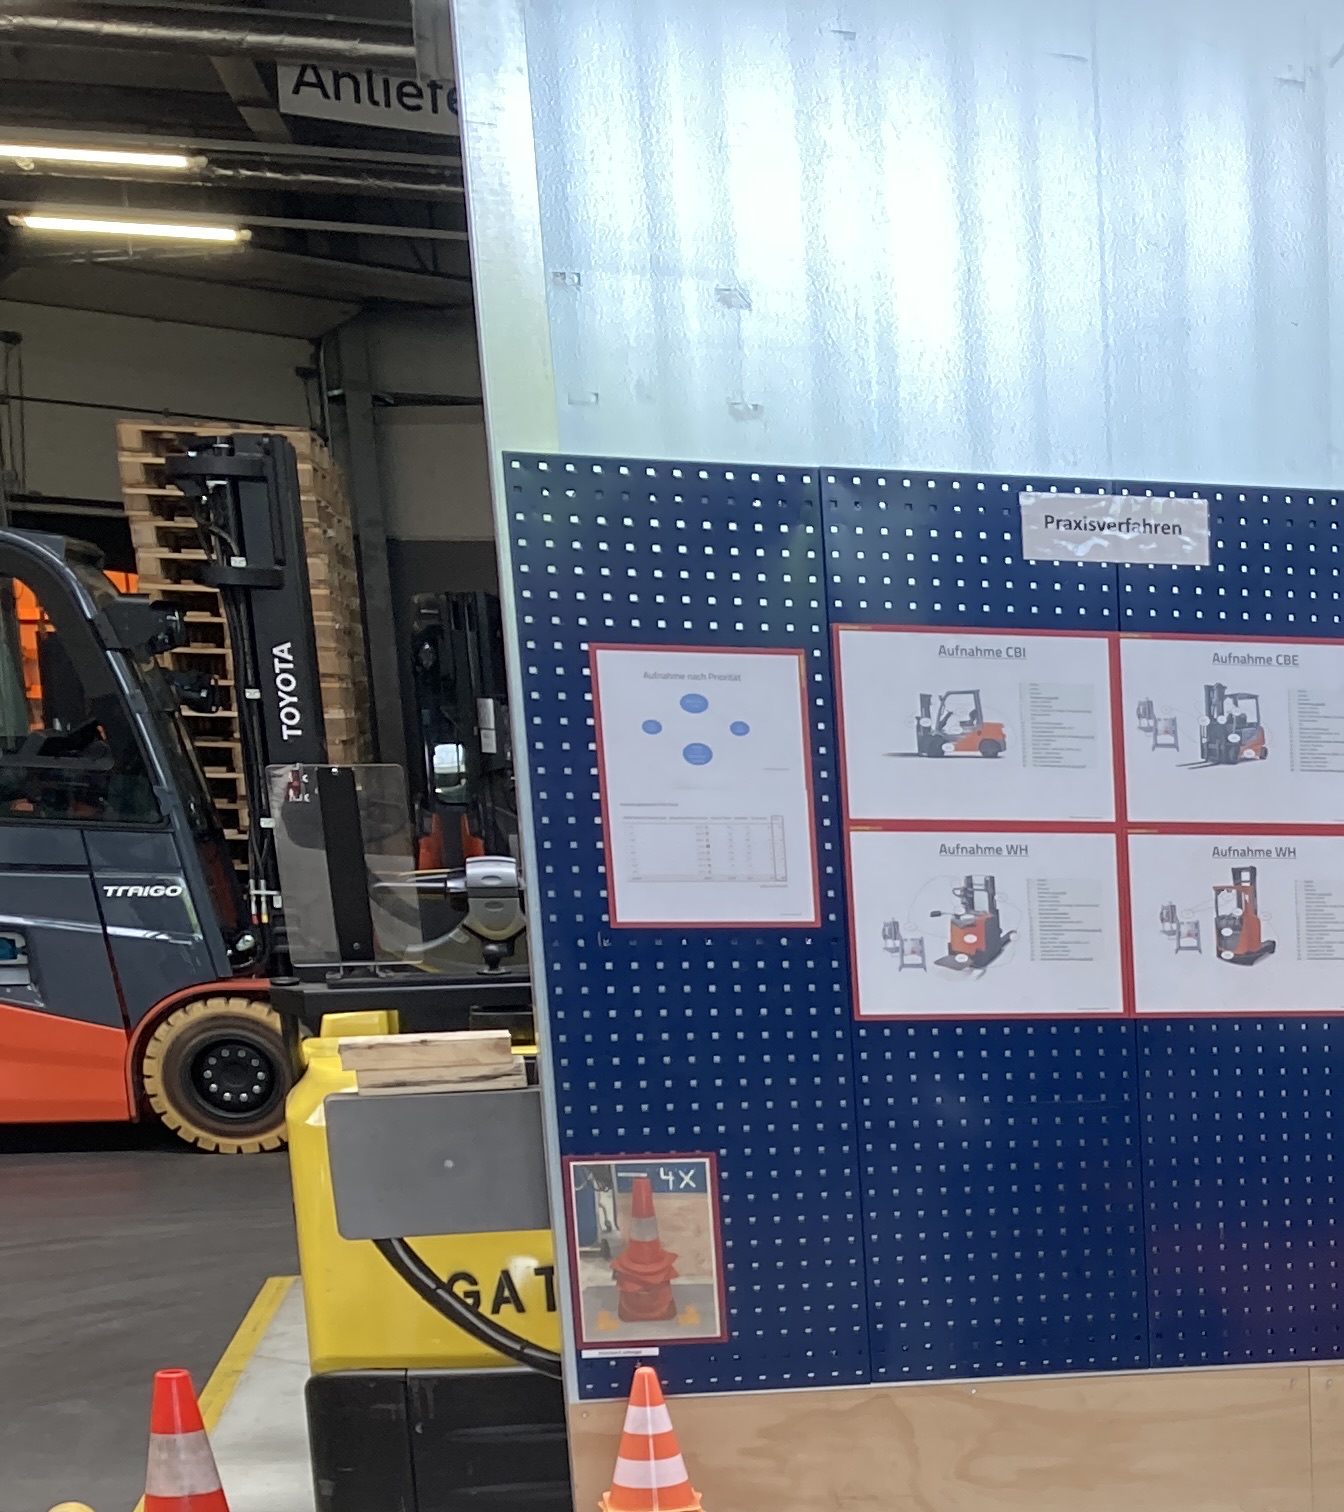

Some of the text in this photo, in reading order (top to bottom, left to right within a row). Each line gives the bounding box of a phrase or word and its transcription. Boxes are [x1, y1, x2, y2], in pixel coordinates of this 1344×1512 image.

[1043, 514, 1183, 536] Praxisverfahren
[938, 645, 1026, 658] Aufnahme CBI
[1212, 652, 1299, 665] Aufnahme CBE
[272, 641, 303, 740] TOYOTA
[939, 843, 1029, 855] Aufnahme WH
[1212, 846, 1297, 858] Aufnahme WH
[103, 885, 183, 897] TRAIGO
